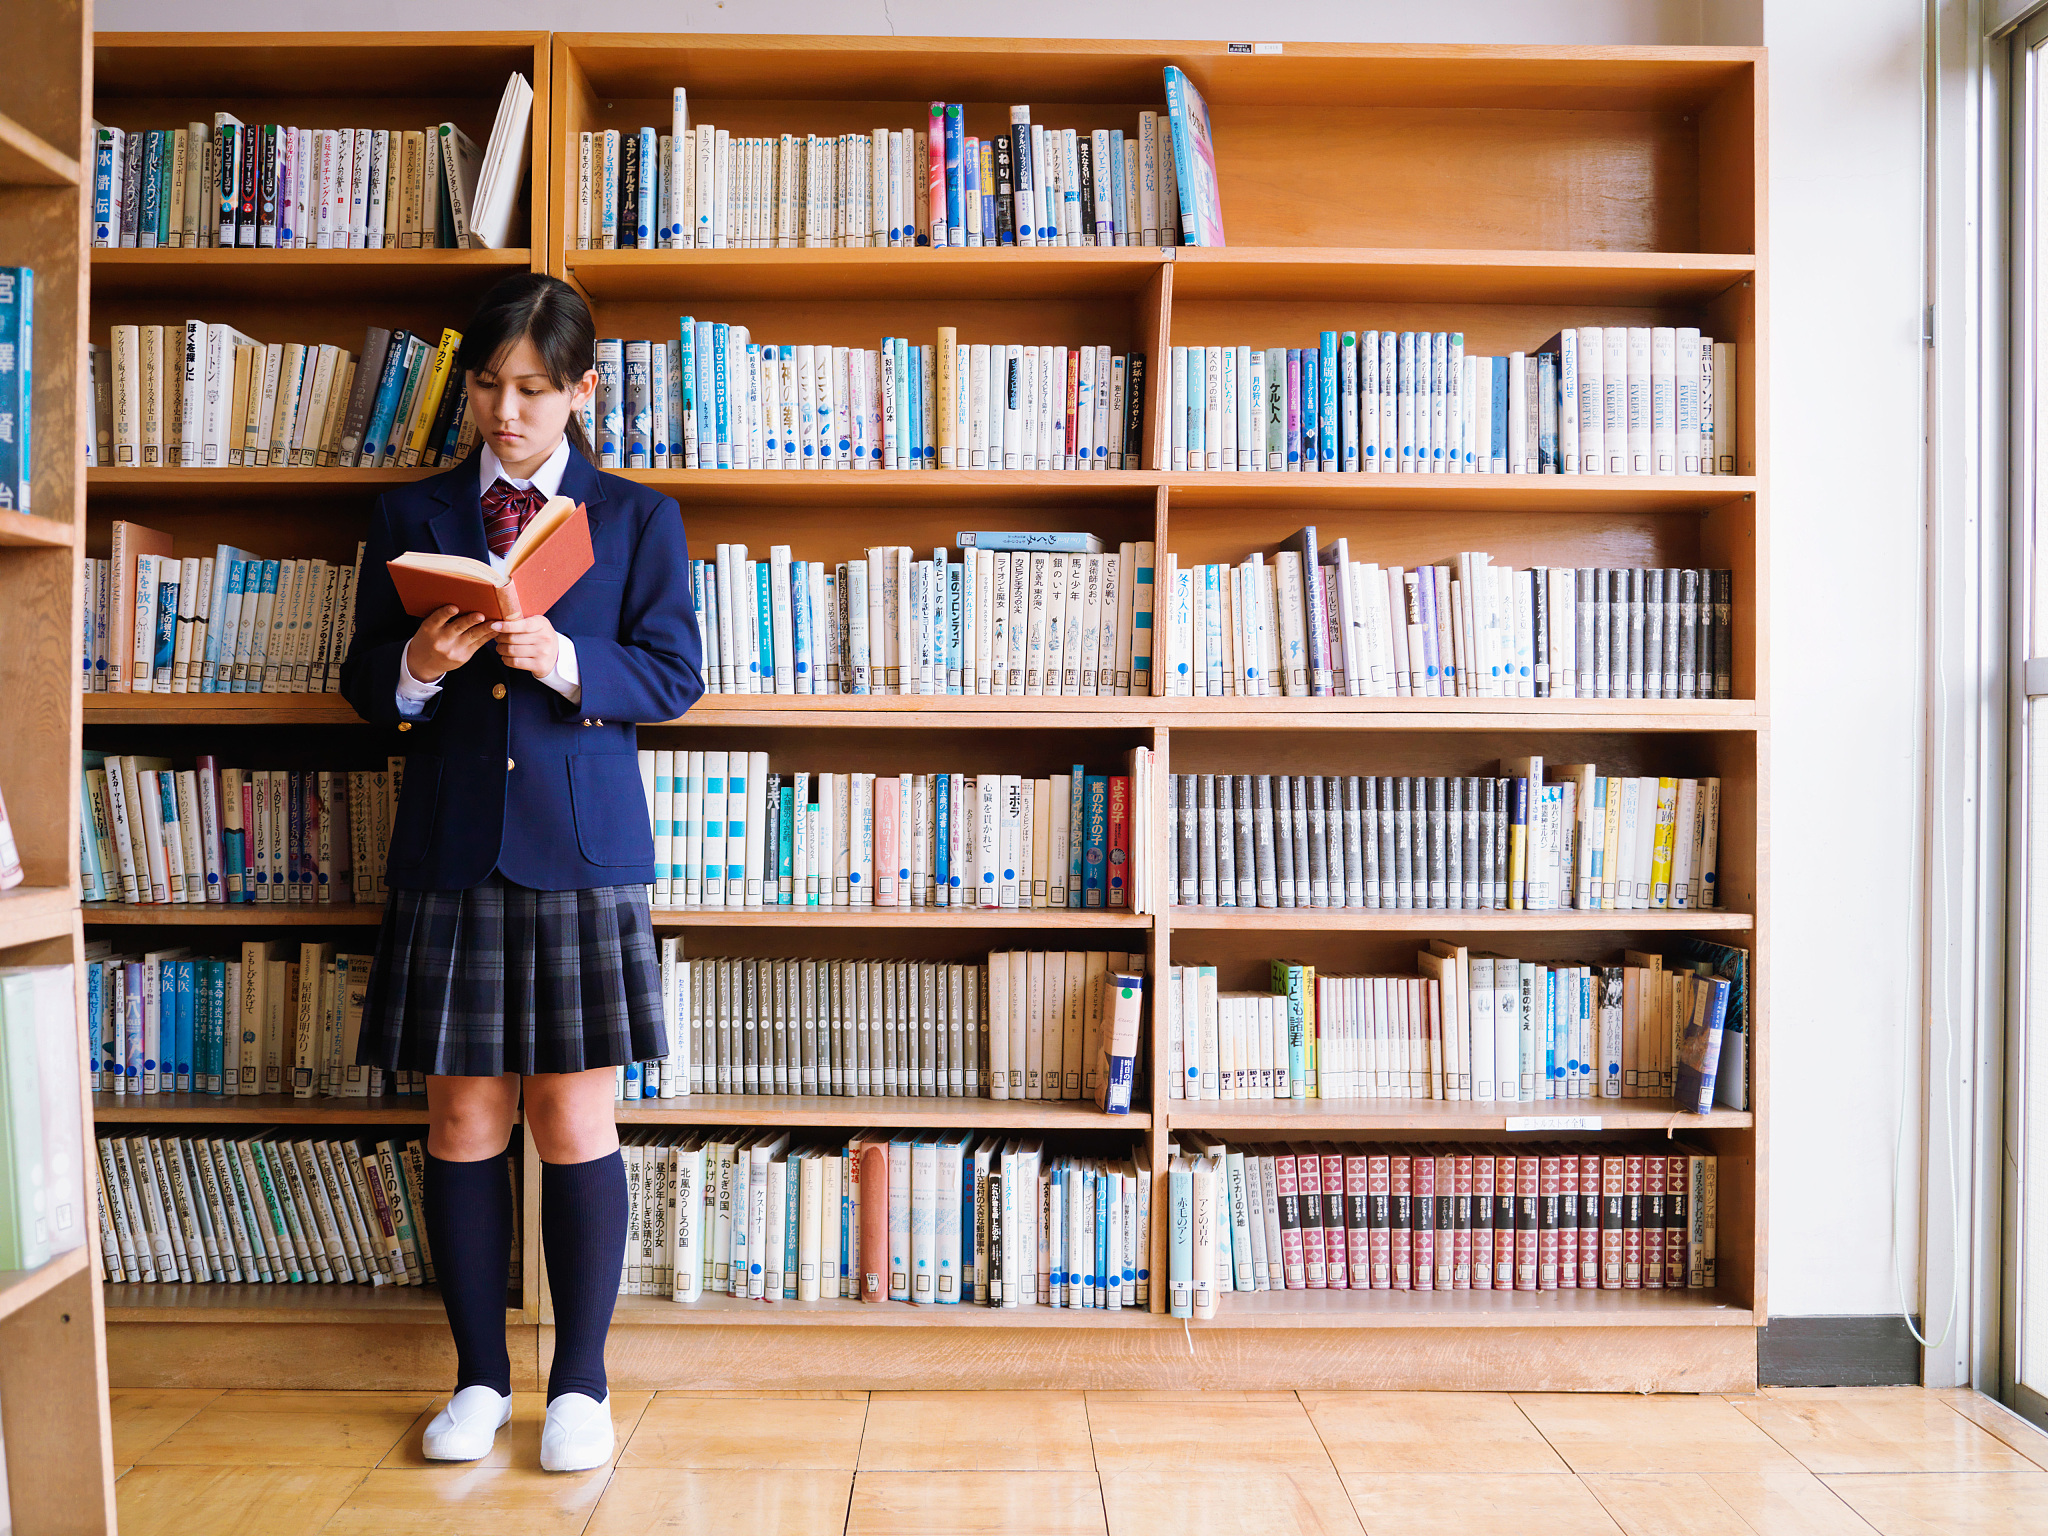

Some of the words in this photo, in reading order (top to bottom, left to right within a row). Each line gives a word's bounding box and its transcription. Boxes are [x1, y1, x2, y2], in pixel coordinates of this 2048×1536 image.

[97, 151, 111, 213] 水滸伝
[126, 133, 138, 211] ワイルド・スワン
[146, 132, 158, 211] ワイルド・スワン
[266, 135, 274, 193] ラゴンラージャ
[625, 137, 636, 212] ネアンデルタール
[207, 331, 218, 382] シートン
[700, 352, 709, 402] TRUCKERS
[716, 353, 724, 404] DIGGERS
[1701, 344, 1713, 420] 黒いランプ
[1269, 383, 1281, 424] ケルト人
[136, 558, 152, 616] 熊を放つ
[1052, 556, 1062, 601] 銀のいす
[1070, 556, 1082, 600] 馬と少年
[1091, 781, 1104, 846] 檻のなかの子
[1111, 779, 1123, 824] よその子
[162, 965, 174, 993] 女医
[178, 965, 190, 993] 女医
[246, 949, 256, 1016] ともしびをかかげて
[378, 1147, 404, 1225] 六月のゆり
[629, 1162, 640, 1241] 妖精のすきなお酒
[642, 1161, 654, 1258] ふしぎふしぎ妖精の国
[654, 1161, 666, 1248] 昼の少年と夜の少女
[679, 1167, 691, 1248] 北風のうしろの国
[705, 1158, 716, 1207] かげの国
[719, 1158, 730, 1220] おとぎの国へ
[755, 1189, 764, 1235] ケストナー
